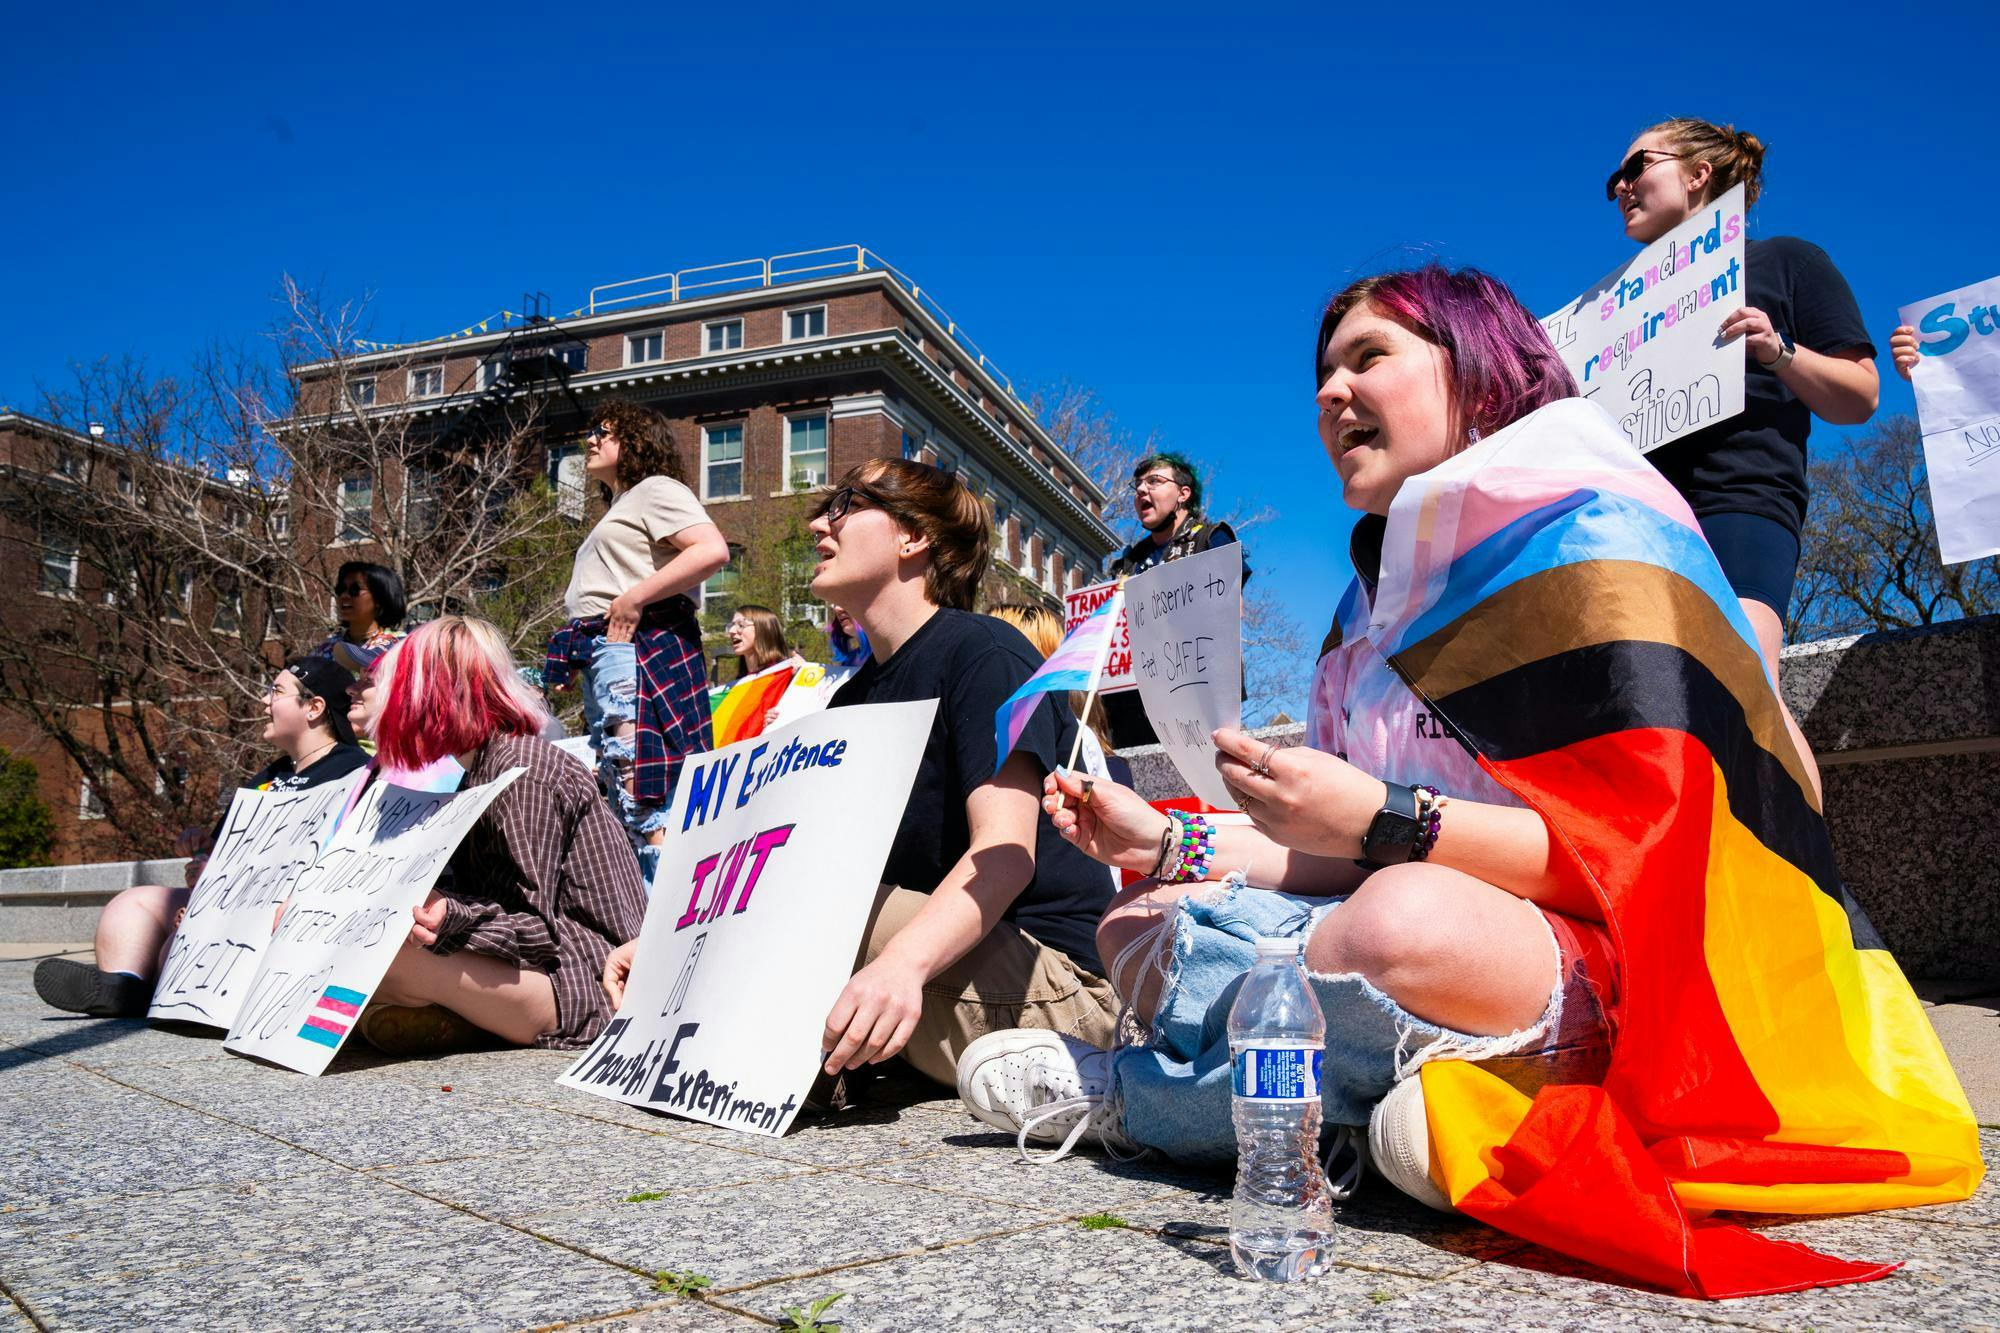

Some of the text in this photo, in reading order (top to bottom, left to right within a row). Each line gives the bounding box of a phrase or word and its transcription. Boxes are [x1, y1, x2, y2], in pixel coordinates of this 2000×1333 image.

[1600, 210, 1741, 322] standards
[1584, 257, 1740, 382] requirement
[1628, 368, 1652, 401] a
[1151, 581, 1194, 620] deserve
[1204, 573, 1226, 598] to
[1163, 637, 1213, 681] SAFE
[357, 787, 421, 834] WHY
[682, 735, 848, 833] MY Existence
[216, 795, 310, 871] HATE
[570, 1017, 796, 1134] Thought Experiment
